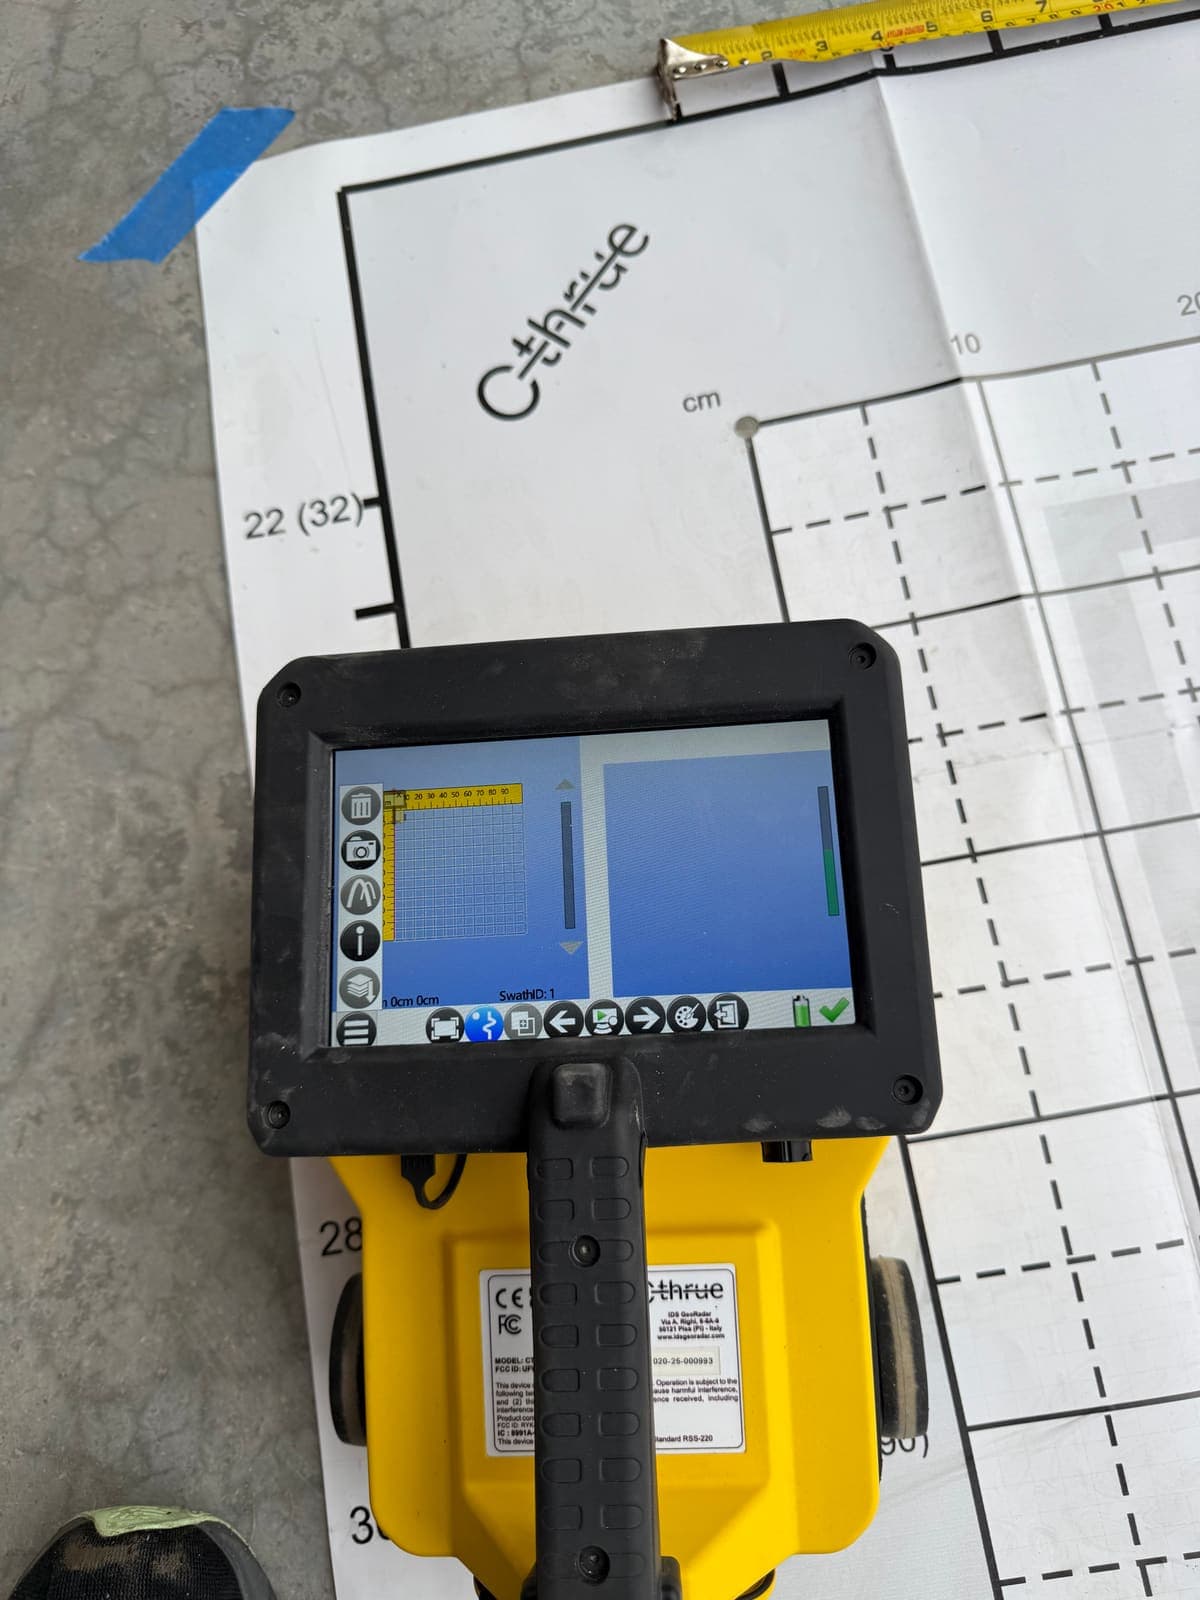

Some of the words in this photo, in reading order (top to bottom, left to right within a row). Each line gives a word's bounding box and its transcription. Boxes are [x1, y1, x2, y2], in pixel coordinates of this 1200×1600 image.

[815, 40, 828, 52] 3
[871, 30, 883, 41] 4
[926, 21, 938, 32] 5
[981, 10, 993, 22] 6
[1035, 0, 1047, 13] 7
[477, 223, 650, 422] Cthrue
[951, 333, 981, 355] 10
[683, 392, 721, 413] cm
[245, 508, 287, 540] 22
[298, 491, 363, 537] (32)
[439, 791, 448, 799] 40
[451, 790, 460, 798] 50
[476, 789, 485, 797] 70
[488, 788, 497, 796] 80
[501, 787, 510, 795] 90
[499, 988, 547, 1001] SwathID:
[549, 988, 555, 999] 1
[391, 996, 414, 1008] 0cm
[416, 995, 439, 1006] 0cm
[320, 1216, 363, 1256] 28
[495, 1357, 524, 1365] MODEL:
[656, 1379, 688, 1387] Operation
[695, 1378, 719, 1386] subject
[496, 1390, 524, 1398] following
[707, 1394, 739, 1403] including
[682, 1434, 714, 1442] RSS-220
[350, 1505, 390, 1545] 3
